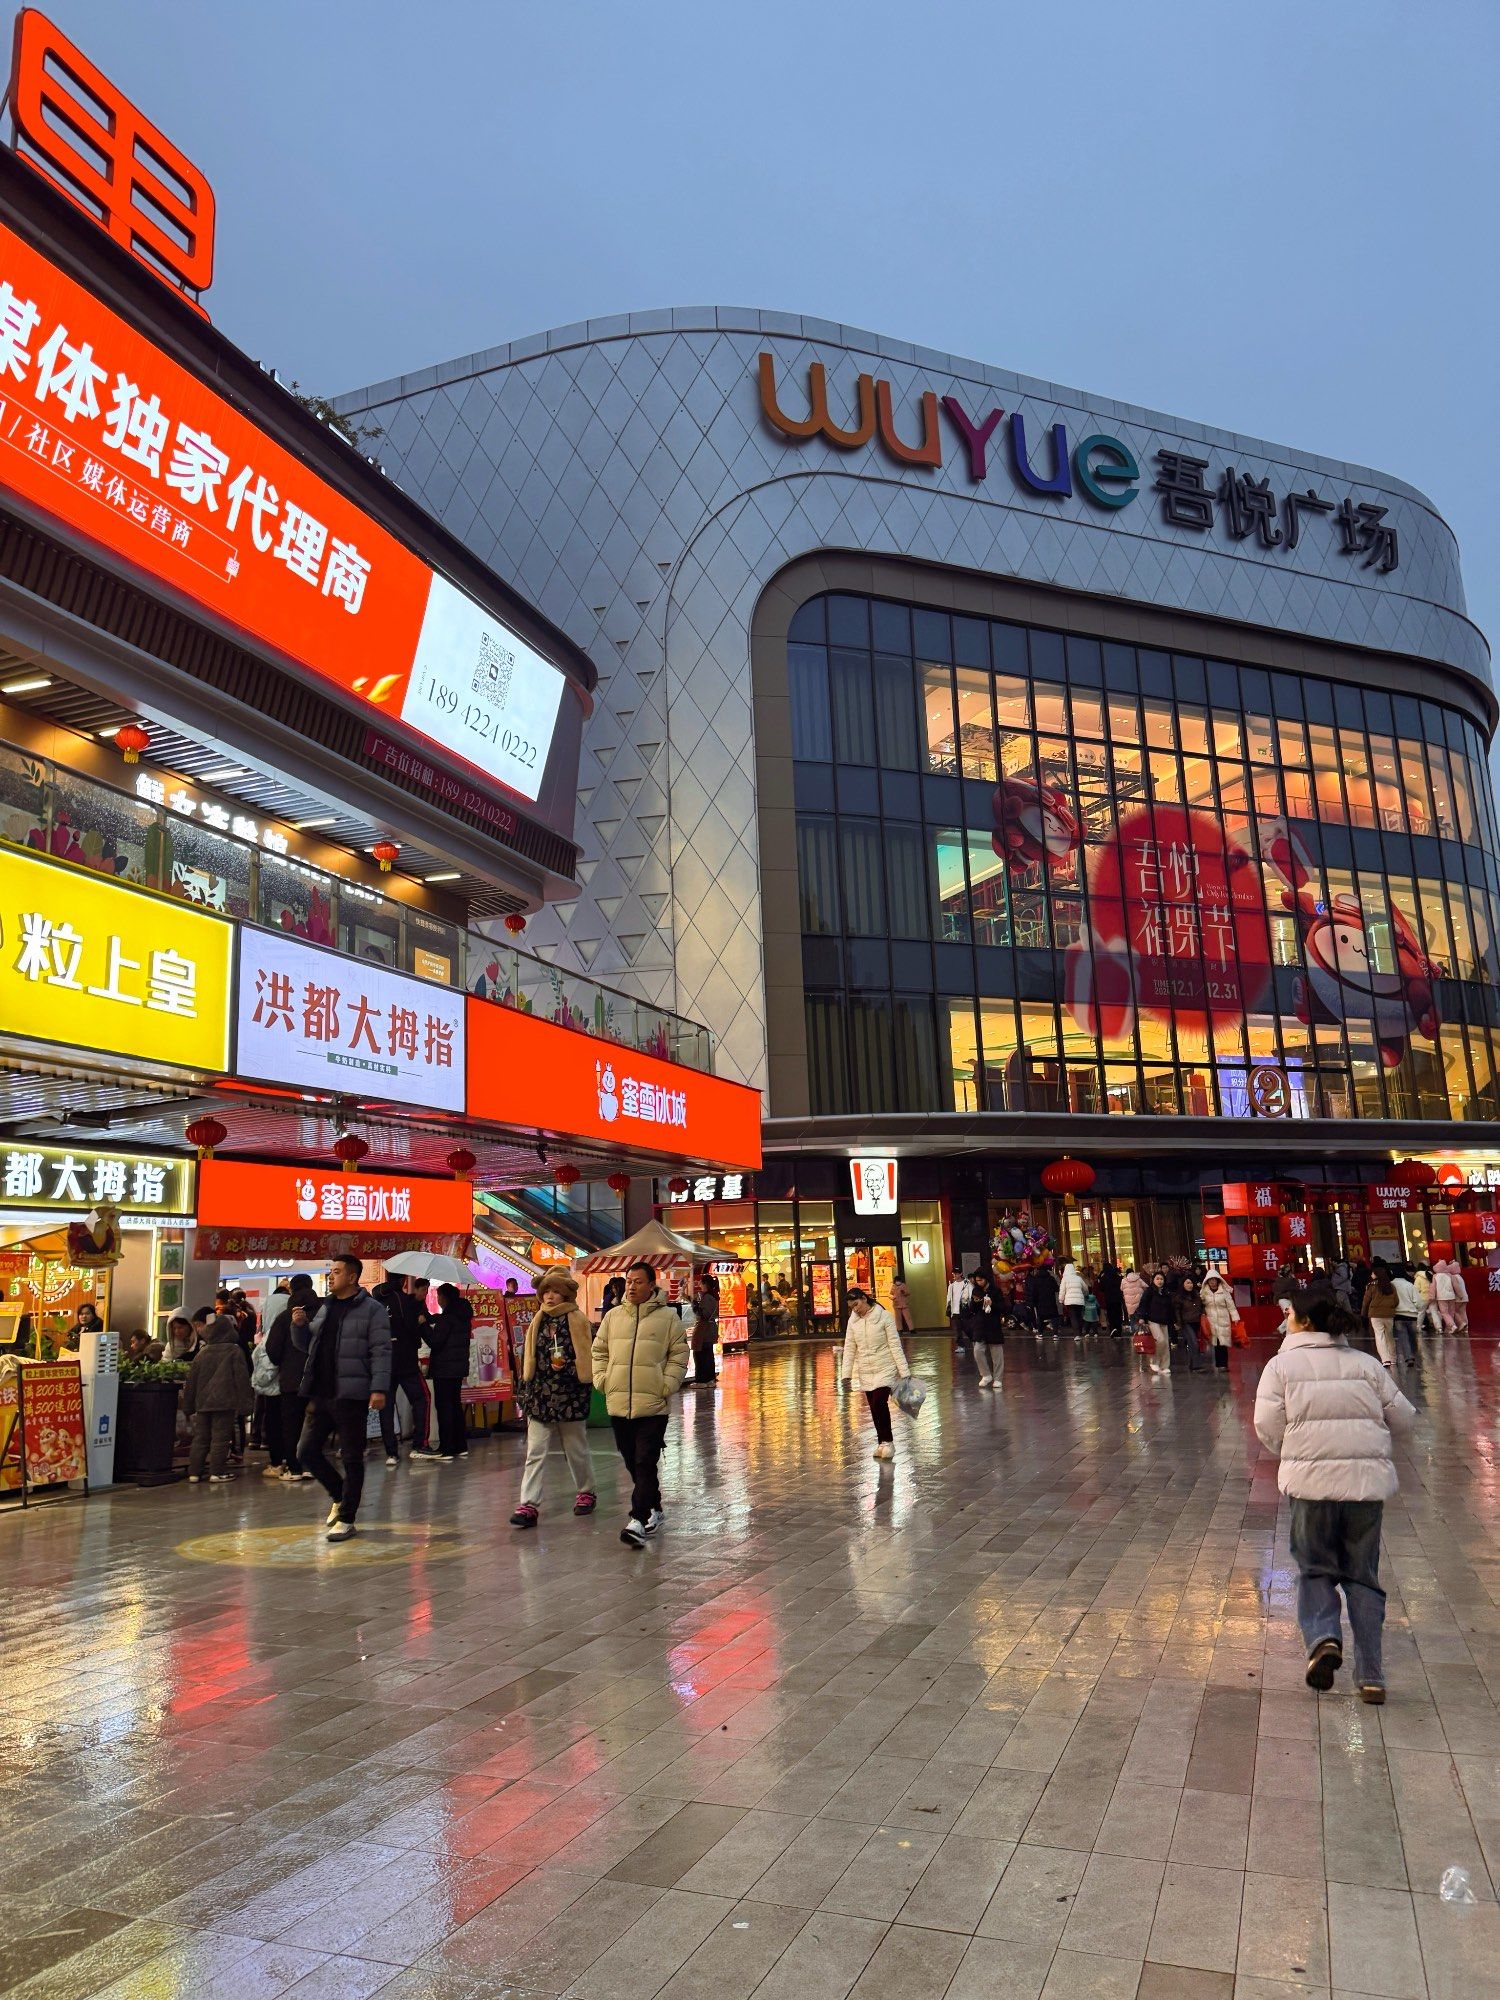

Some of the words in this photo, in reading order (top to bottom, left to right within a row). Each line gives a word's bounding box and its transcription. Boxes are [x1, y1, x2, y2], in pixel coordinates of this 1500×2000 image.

[1155, 448, 1399, 573] 吾悦广场
[428, 677, 459, 715] 189
[501, 729, 538, 769] 0222
[488, 804, 512, 832] 0222
[1133, 838, 1204, 899] 吾悦
[17, 911, 198, 1019] 粒上皇
[1207, 981, 1238, 1000] 12.31
[252, 968, 454, 1068] 洪都大拇指
[621, 1076, 687, 1129] 蜜雪冰城
[320, 1182, 411, 1222] 蜜雪冰城
[1255, 1186, 1272, 1208] 福
[1288, 1216, 1307, 1238] 聚
[1481, 1216, 1496, 1235] 运
[1262, 1248, 1280, 1271] 吾
